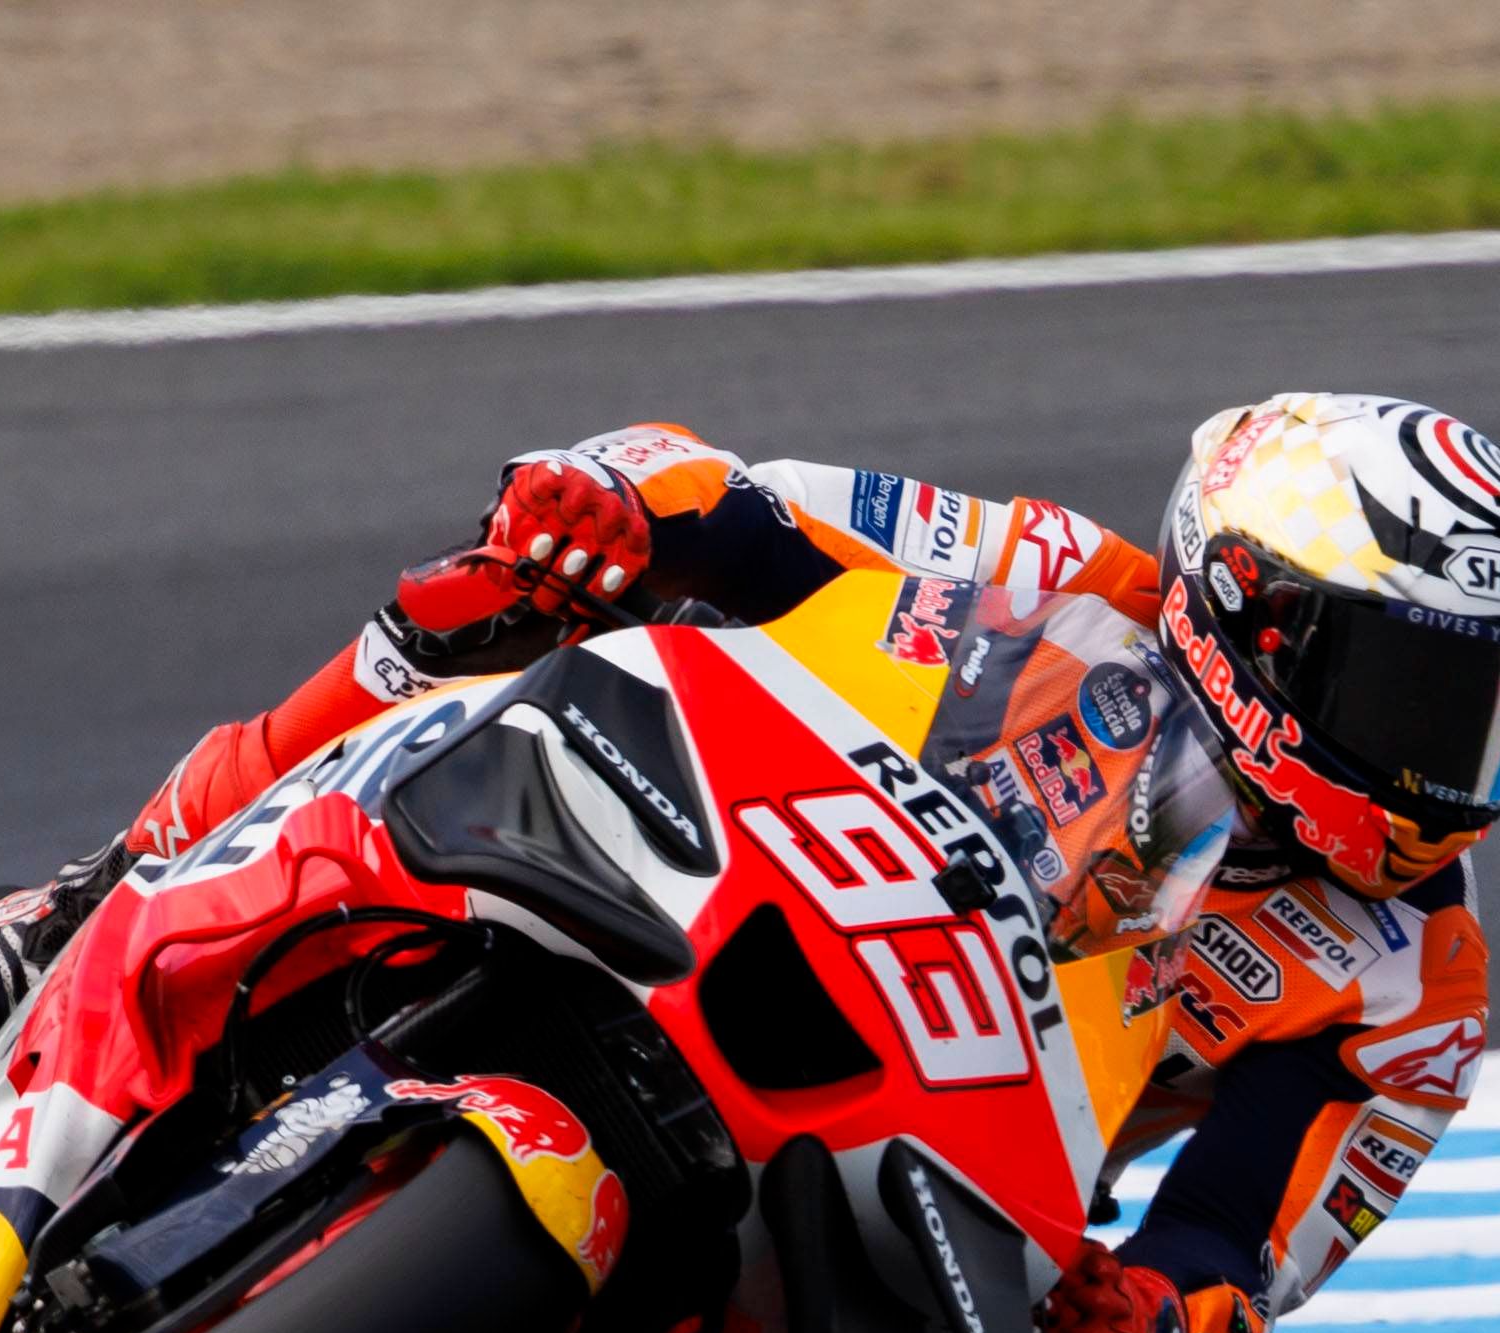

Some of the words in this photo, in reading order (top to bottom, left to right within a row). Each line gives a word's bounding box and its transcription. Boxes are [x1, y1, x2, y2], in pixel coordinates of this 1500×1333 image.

[930, 489, 962, 561] PSOL
[1407, 606, 1481, 637] GIVES
[561, 702, 702, 850] HONDA
[847, 741, 1064, 1052] REPSOL
[1270, 896, 1358, 973] REPSOL
[732, 785, 1036, 1092] 93
[1194, 919, 1275, 995] SHOEI
[1360, 1134, 1420, 1179] REP
